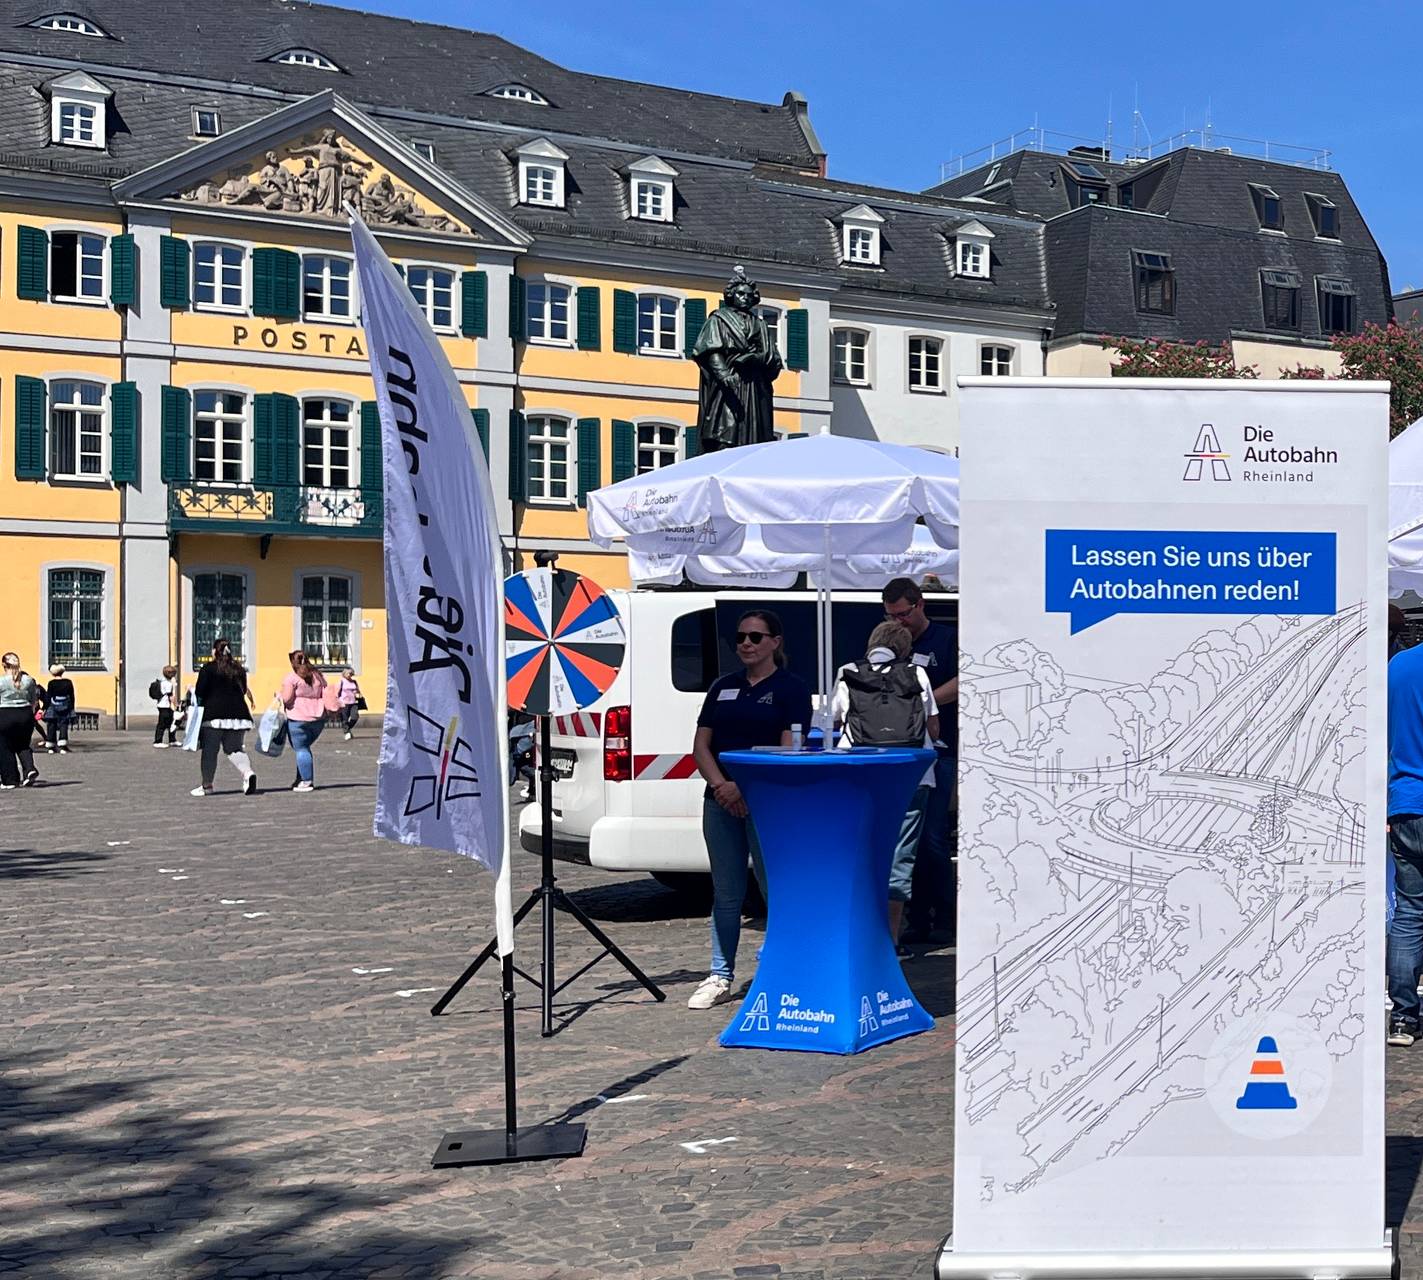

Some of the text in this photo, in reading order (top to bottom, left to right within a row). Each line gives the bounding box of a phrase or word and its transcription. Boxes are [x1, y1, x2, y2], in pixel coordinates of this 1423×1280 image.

[233, 325, 364, 356] POSTA
[1244, 425, 1274, 442] Die
[1244, 446, 1338, 463] Autobahn
[1243, 471, 1314, 482] Rheinland
[1071, 544, 1313, 568] Lassen Sie uns über
[1070, 577, 1299, 601] Autobahnen reden!
[780, 993, 800, 1007] Die
[876, 990, 889, 1004] Die
[879, 997, 914, 1016] Autobahn
[778, 1007, 835, 1024] Autobahn
[775, 1022, 819, 1034] Rheinland
